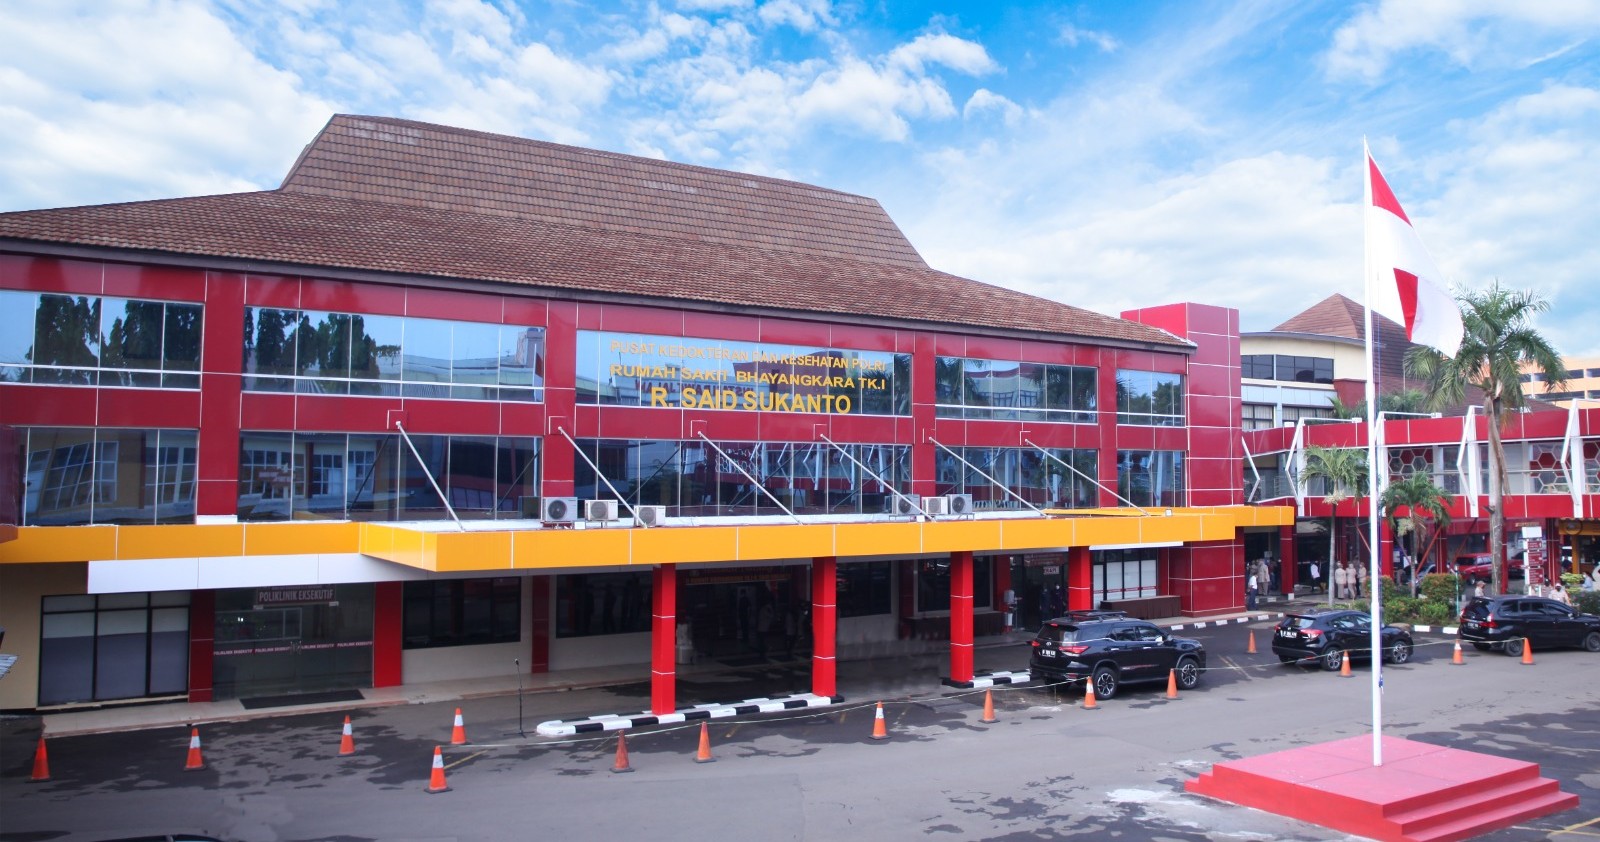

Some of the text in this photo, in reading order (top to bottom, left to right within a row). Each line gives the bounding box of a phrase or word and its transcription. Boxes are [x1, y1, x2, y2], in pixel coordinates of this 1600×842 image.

[610, 339, 886, 371] PUSAT KEDOKTERAN DAN KESEHATAN POLRI
[610, 363, 886, 390] RUMAH SAKIT BHAYANGKARA TK.I
[651, 386, 674, 407] R.
[681, 387, 737, 410] SAID
[742, 390, 852, 414] SUKANTO
[258, 588, 334, 602] POLIKLINIK EKSEKUTIF
